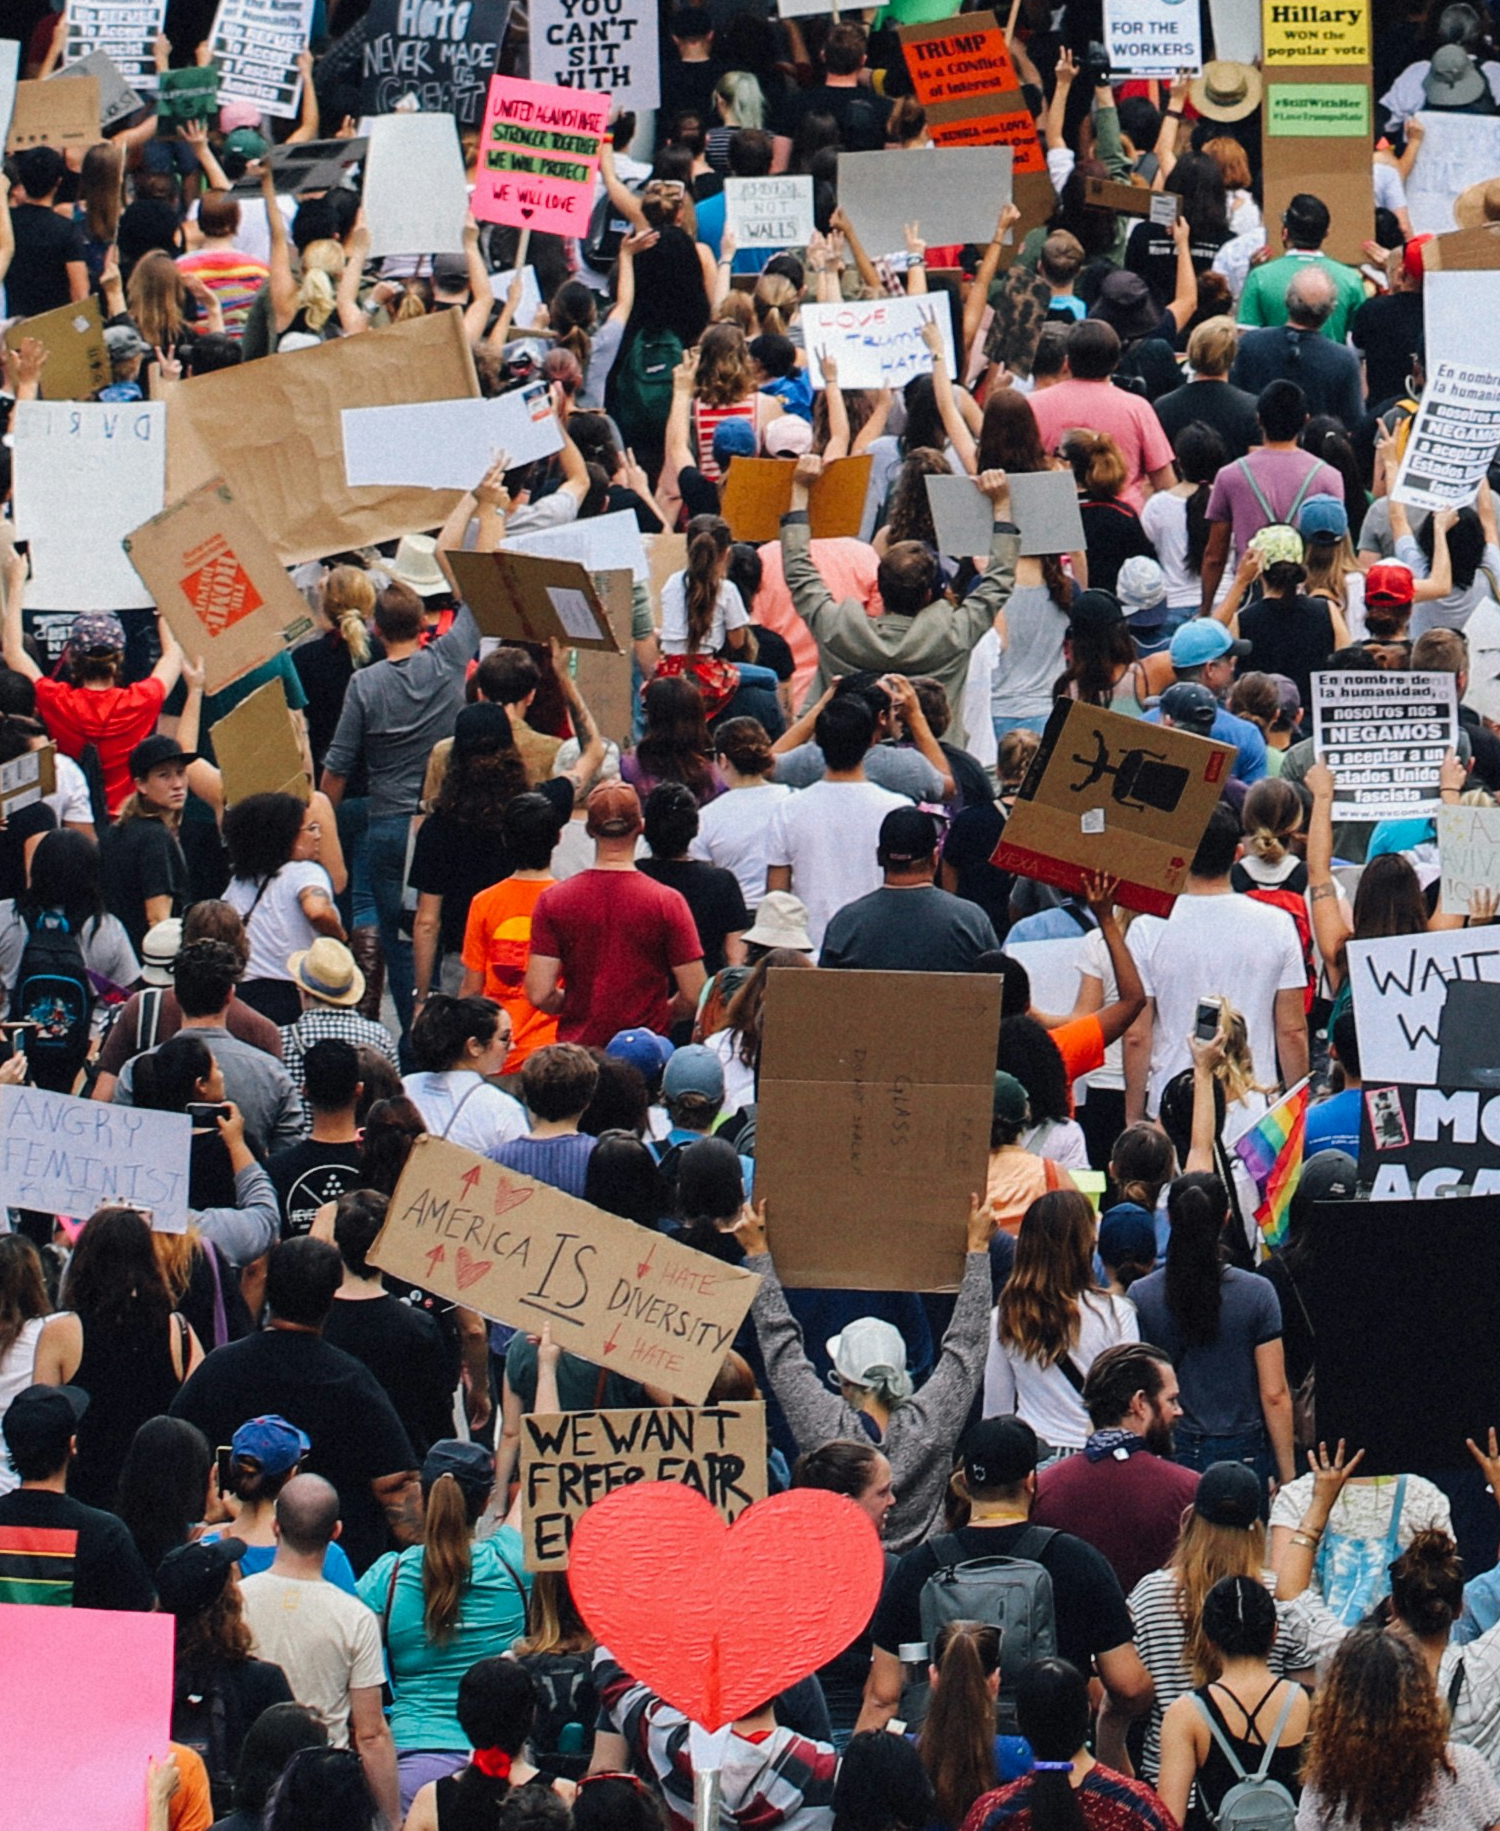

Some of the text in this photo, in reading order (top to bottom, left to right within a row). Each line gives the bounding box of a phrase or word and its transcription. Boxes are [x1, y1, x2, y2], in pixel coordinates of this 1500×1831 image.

[1271, 4, 1361, 25] Hillary
[547, 20, 638, 45] CAN'T
[1284, 29, 1345, 40] WON the
[363, 42, 496, 76] NEVER MADE
[569, 44, 617, 66] SIT
[1267, 44, 1366, 58] popular vote
[554, 67, 631, 89] WITH
[402, 1188, 734, 1354] AMERICA IS DIVERSITY
